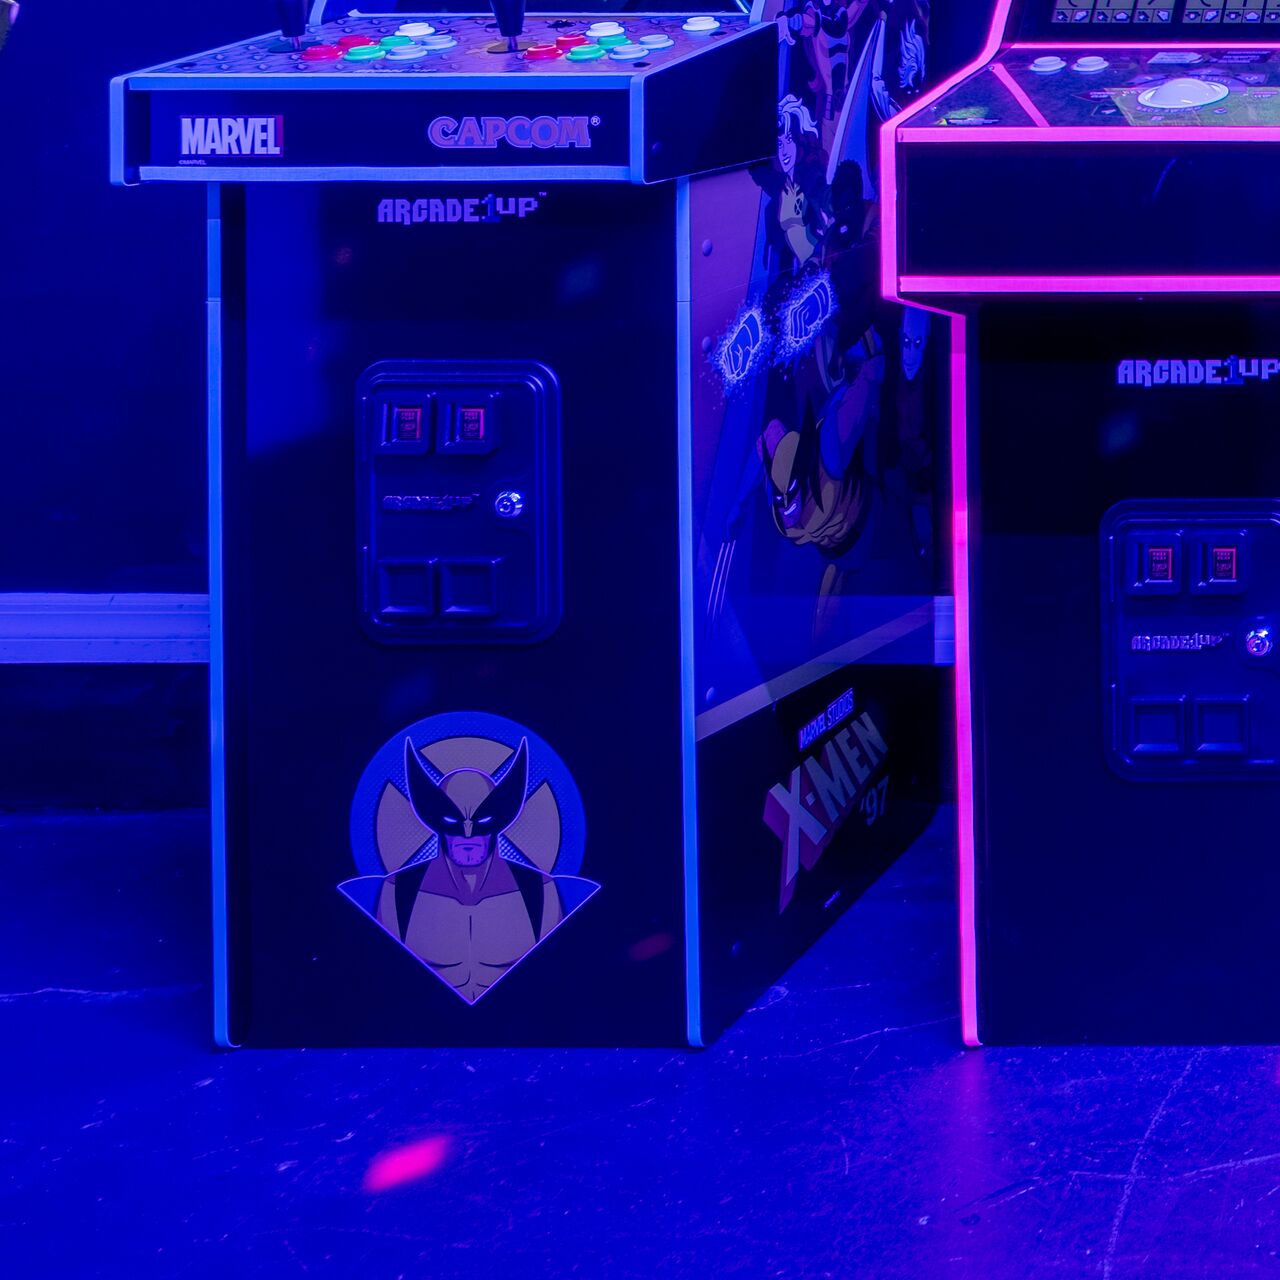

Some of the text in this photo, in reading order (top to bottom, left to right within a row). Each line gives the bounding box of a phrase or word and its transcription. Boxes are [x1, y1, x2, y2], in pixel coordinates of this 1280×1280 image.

[181, 117, 281, 155] MARVEL
[377, 192, 538, 225] ARCADE1UP
[763, 711, 889, 917] X-MEN
